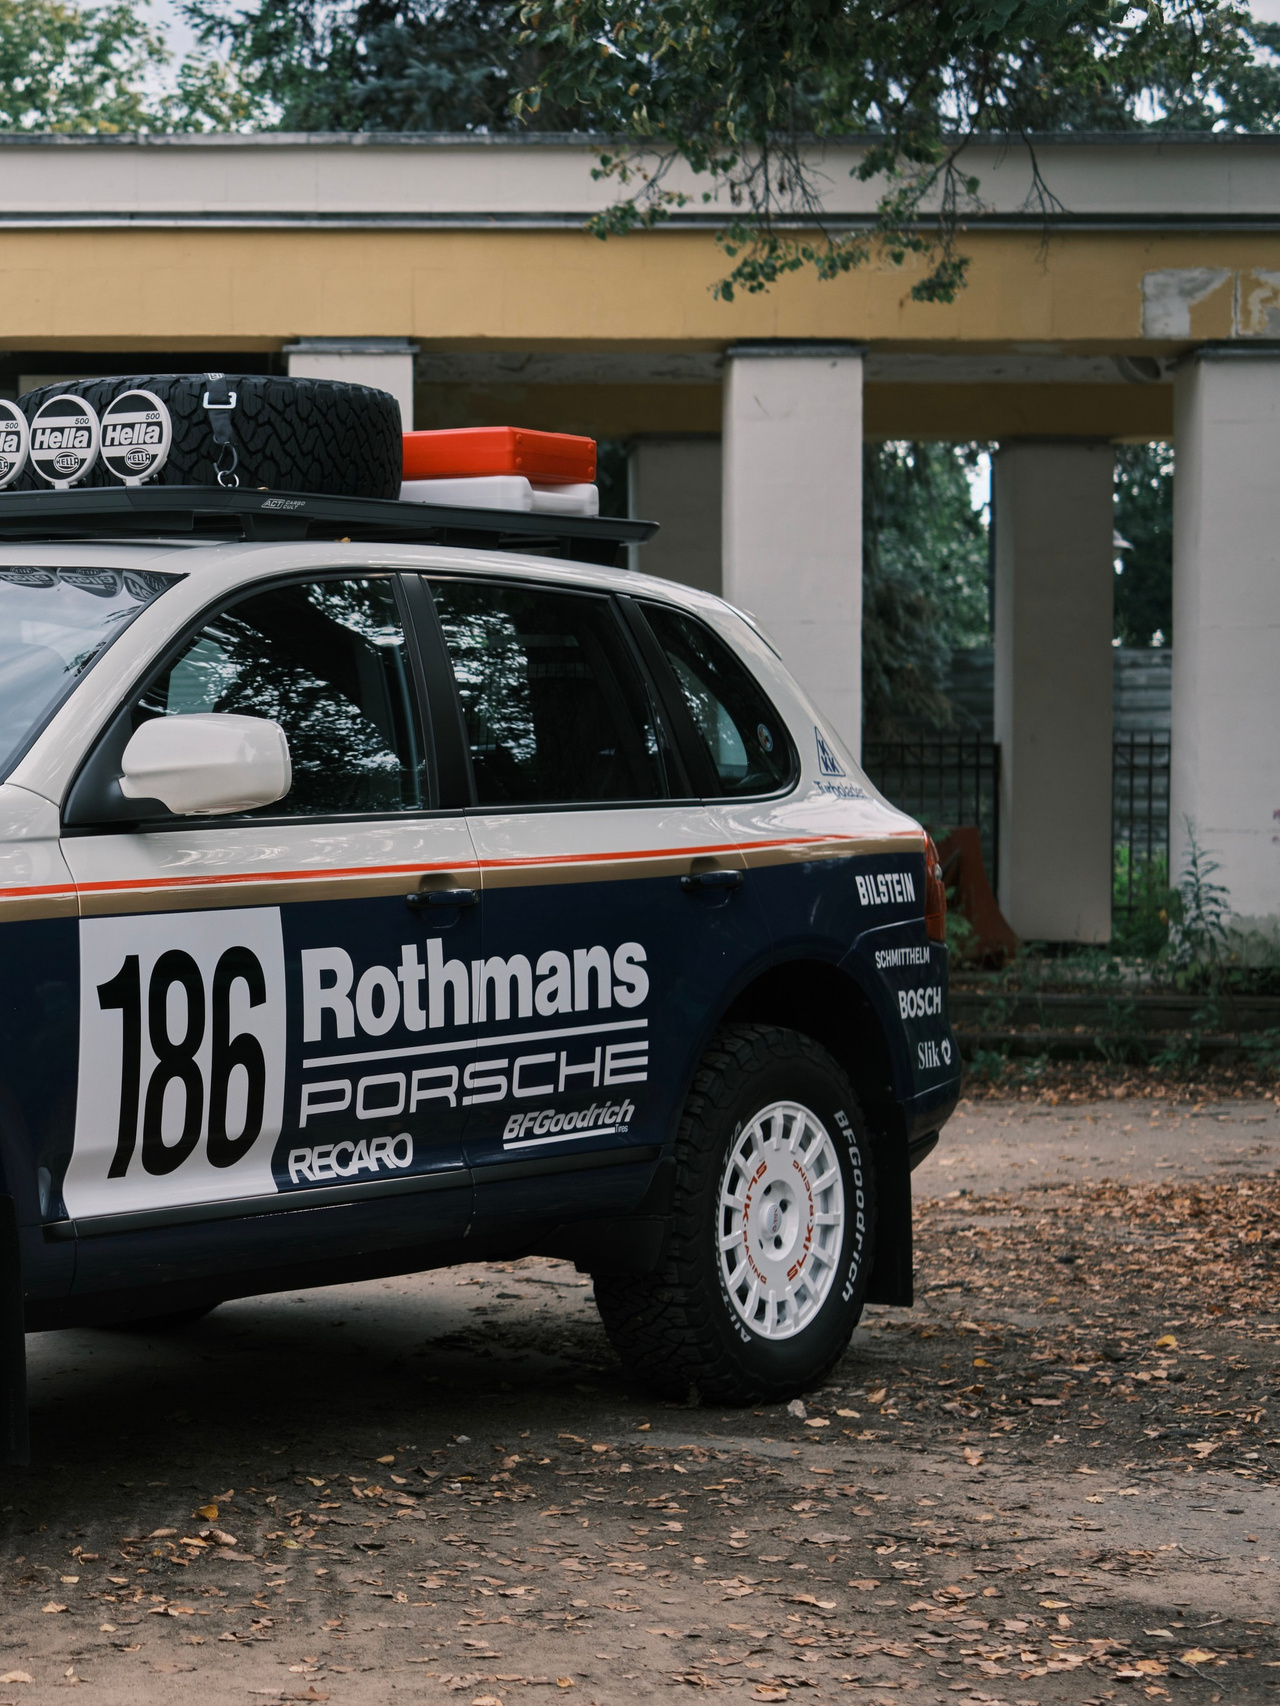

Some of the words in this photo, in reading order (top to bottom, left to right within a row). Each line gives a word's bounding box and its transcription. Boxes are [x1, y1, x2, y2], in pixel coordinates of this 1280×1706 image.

[5, 422, 19, 430] 500
[34, 428, 89, 449] Hella
[75, 417, 89, 425] 500
[104, 423, 161, 446] Hella
[56, 457, 80, 466] HELLA
[127, 453, 150, 463] HELLA
[855, 873, 916, 906] BILSTEIN
[875, 946, 930, 969] SCHMITTHELM
[301, 937, 651, 1043] Rothmans
[898, 986, 942, 1020] BOSCH
[96, 945, 268, 1180] 186
[918, 1039, 941, 1070] Slik
[299, 1040, 649, 1129] PORSCHE
[502, 1099, 636, 1140] BFGoodrich
[288, 1132, 414, 1184] RECARO
[742, 1160, 768, 1224] SLIK
[792, 1159, 815, 1217] RACING
[833, 1109, 866, 1303] BFGoodrich
[742, 1230, 768, 1285] RACING
[786, 1224, 815, 1283] SLIK
